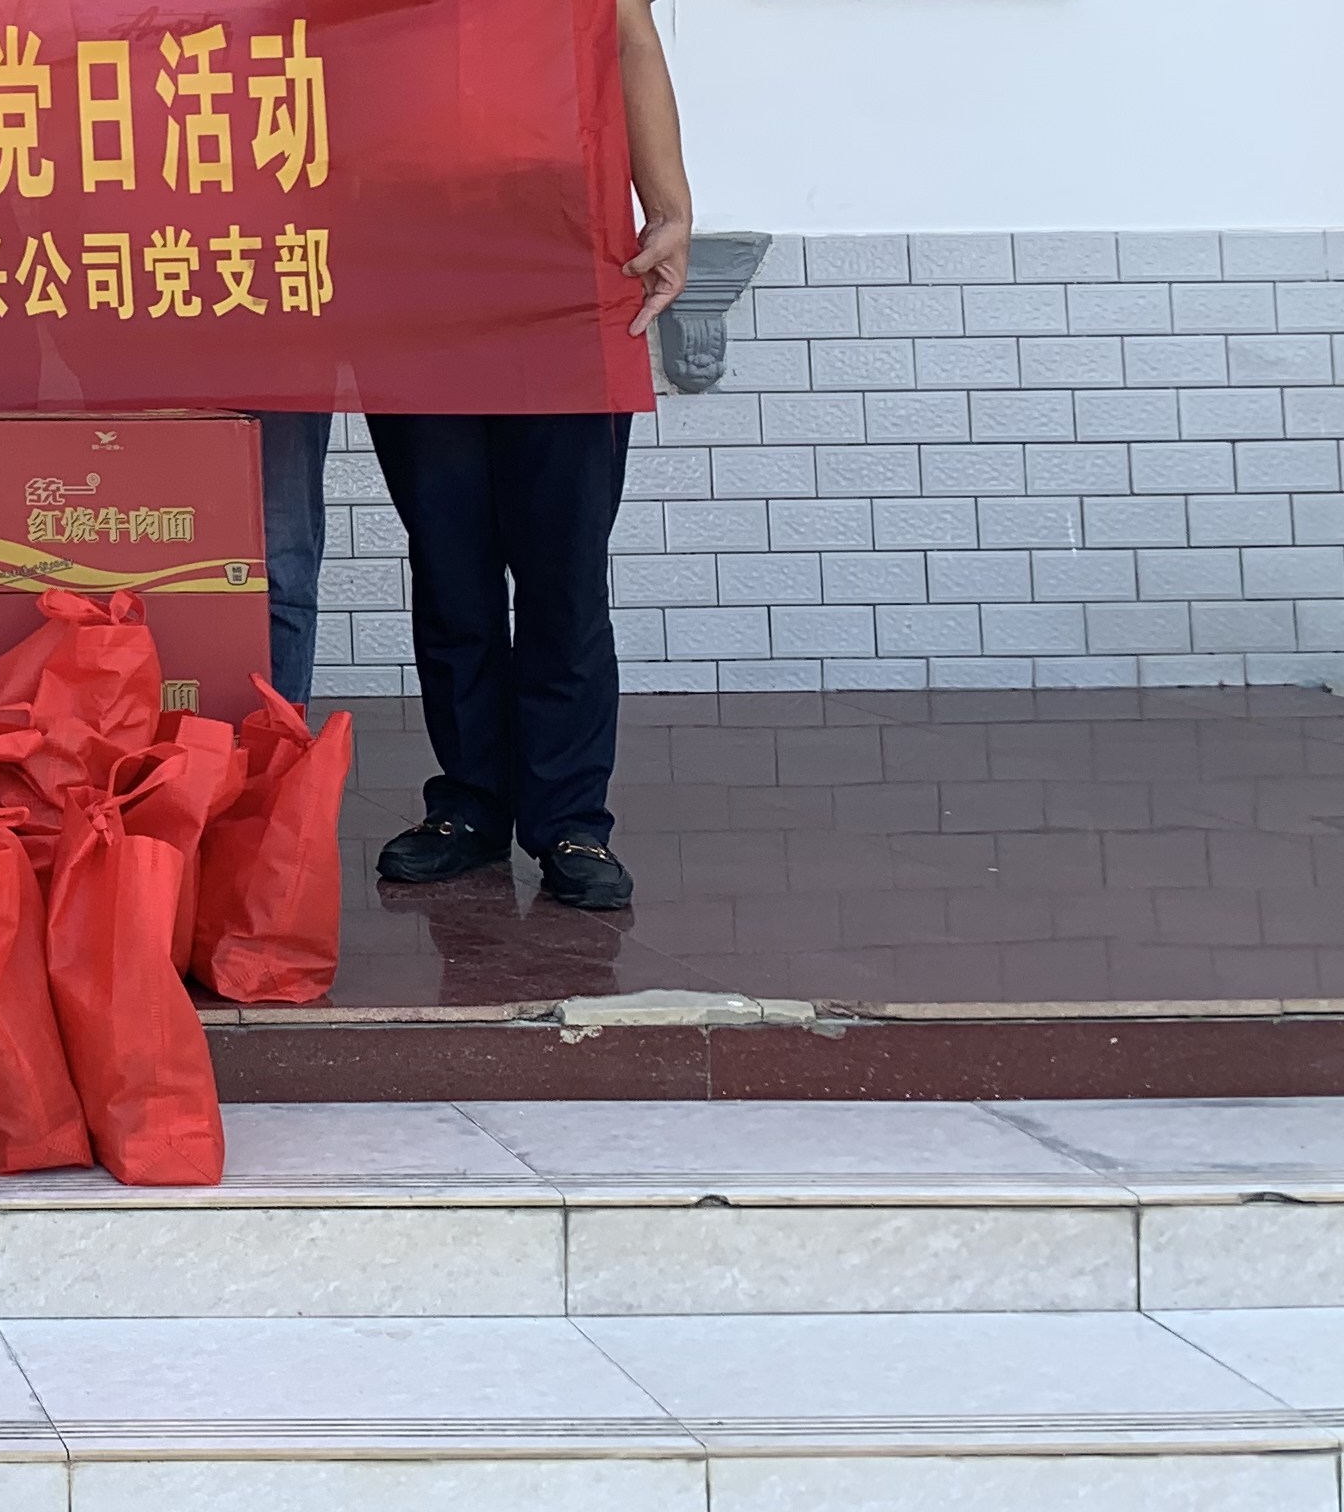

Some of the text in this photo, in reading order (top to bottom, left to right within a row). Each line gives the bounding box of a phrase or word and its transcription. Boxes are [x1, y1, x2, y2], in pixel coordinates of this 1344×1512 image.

[26, 506, 196, 544] 红烧牛肉面
